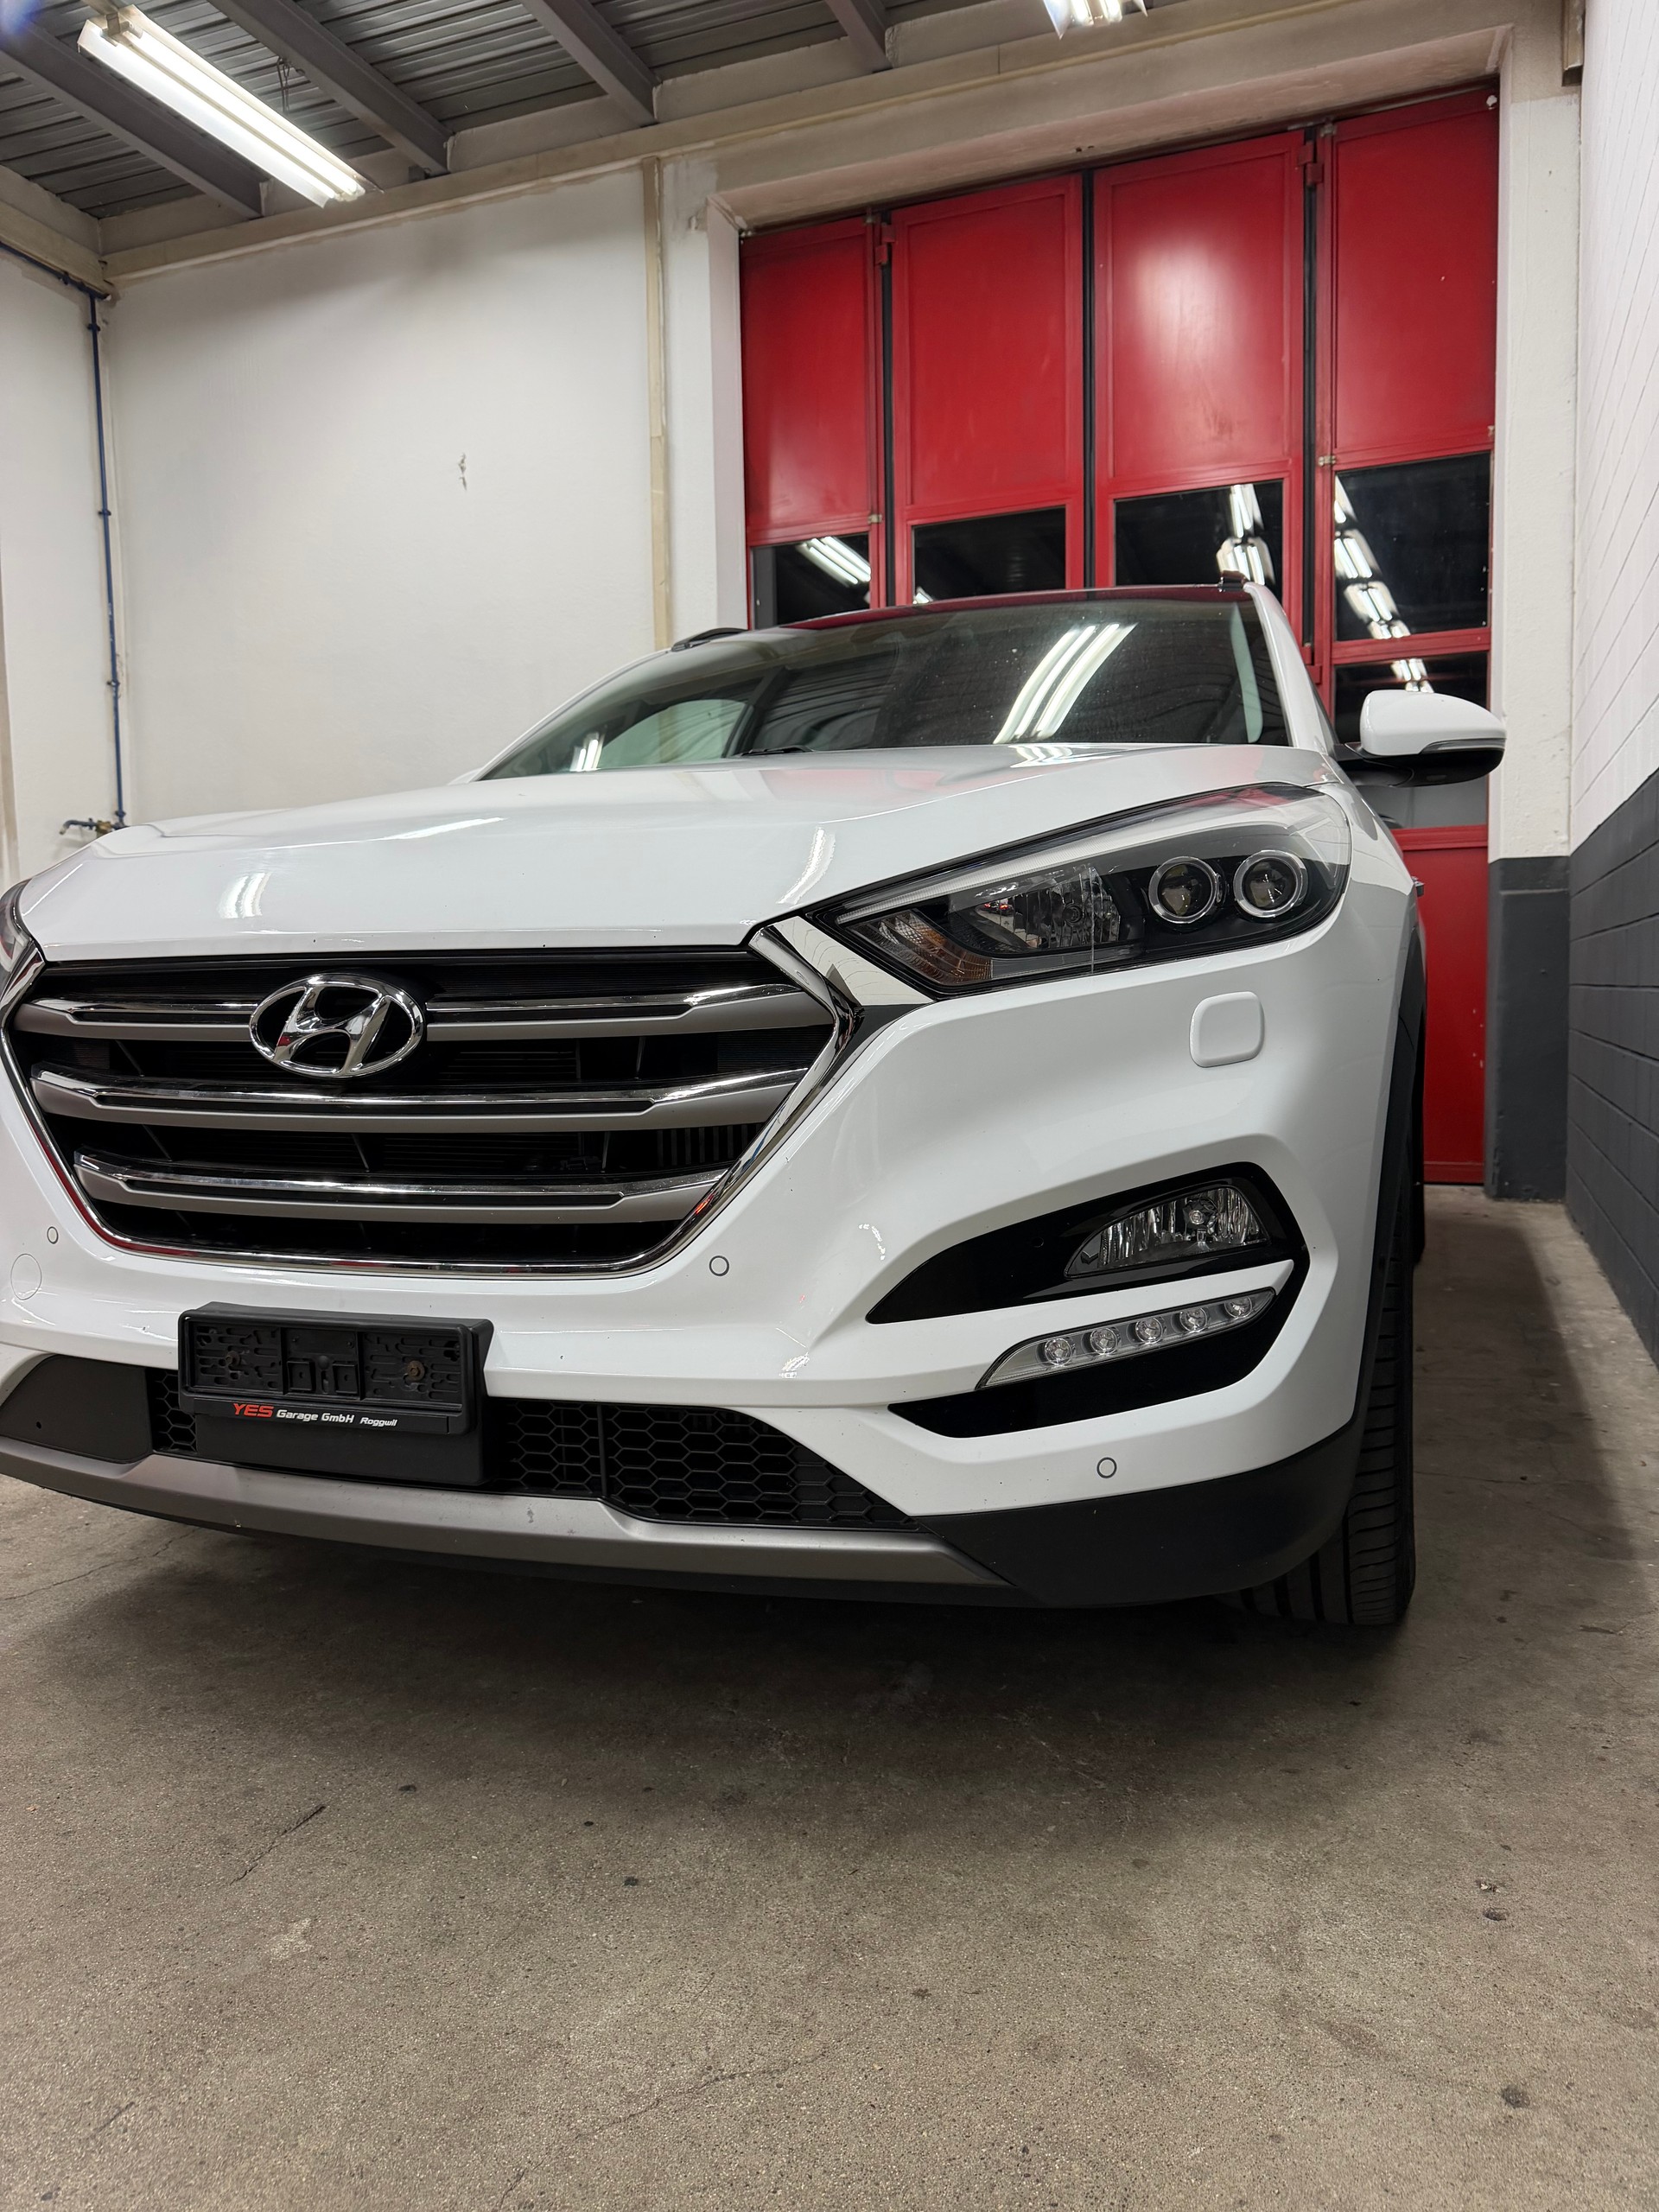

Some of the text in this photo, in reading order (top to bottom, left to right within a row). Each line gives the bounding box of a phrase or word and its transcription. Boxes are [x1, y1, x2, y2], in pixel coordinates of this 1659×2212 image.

[233, 1402, 397, 1427] YES Garage GmbH Roggwil
